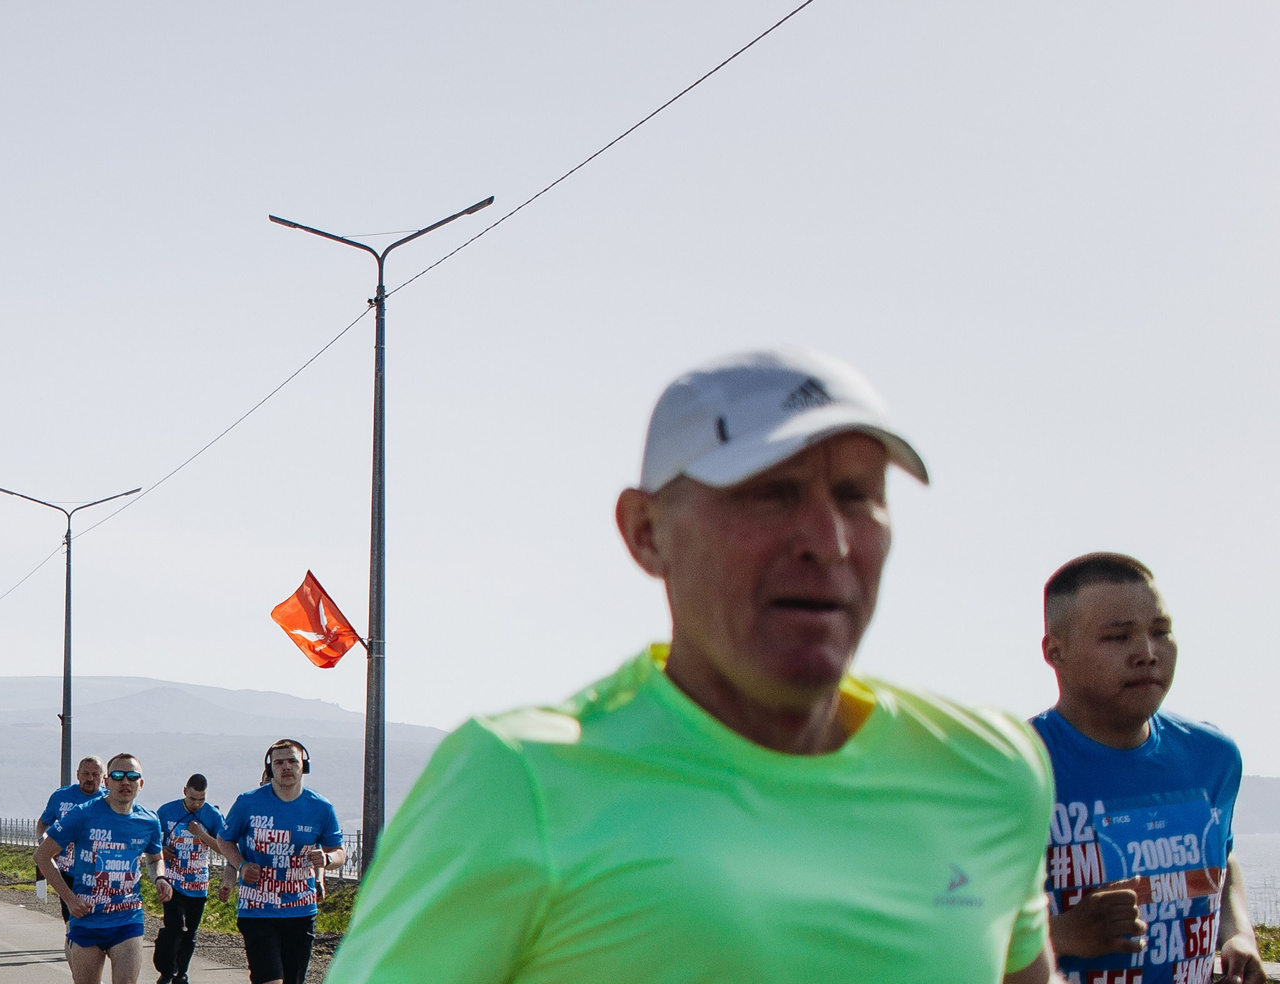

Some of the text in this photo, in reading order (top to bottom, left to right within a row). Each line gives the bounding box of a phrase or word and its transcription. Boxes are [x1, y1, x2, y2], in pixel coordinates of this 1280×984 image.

[249, 815, 274, 829] 2024
[89, 828, 112, 841] 2024
[253, 828, 291, 843] #МЕЧТА
[1126, 833, 1200, 873] 20053
[105, 860, 130, 871] 30014
